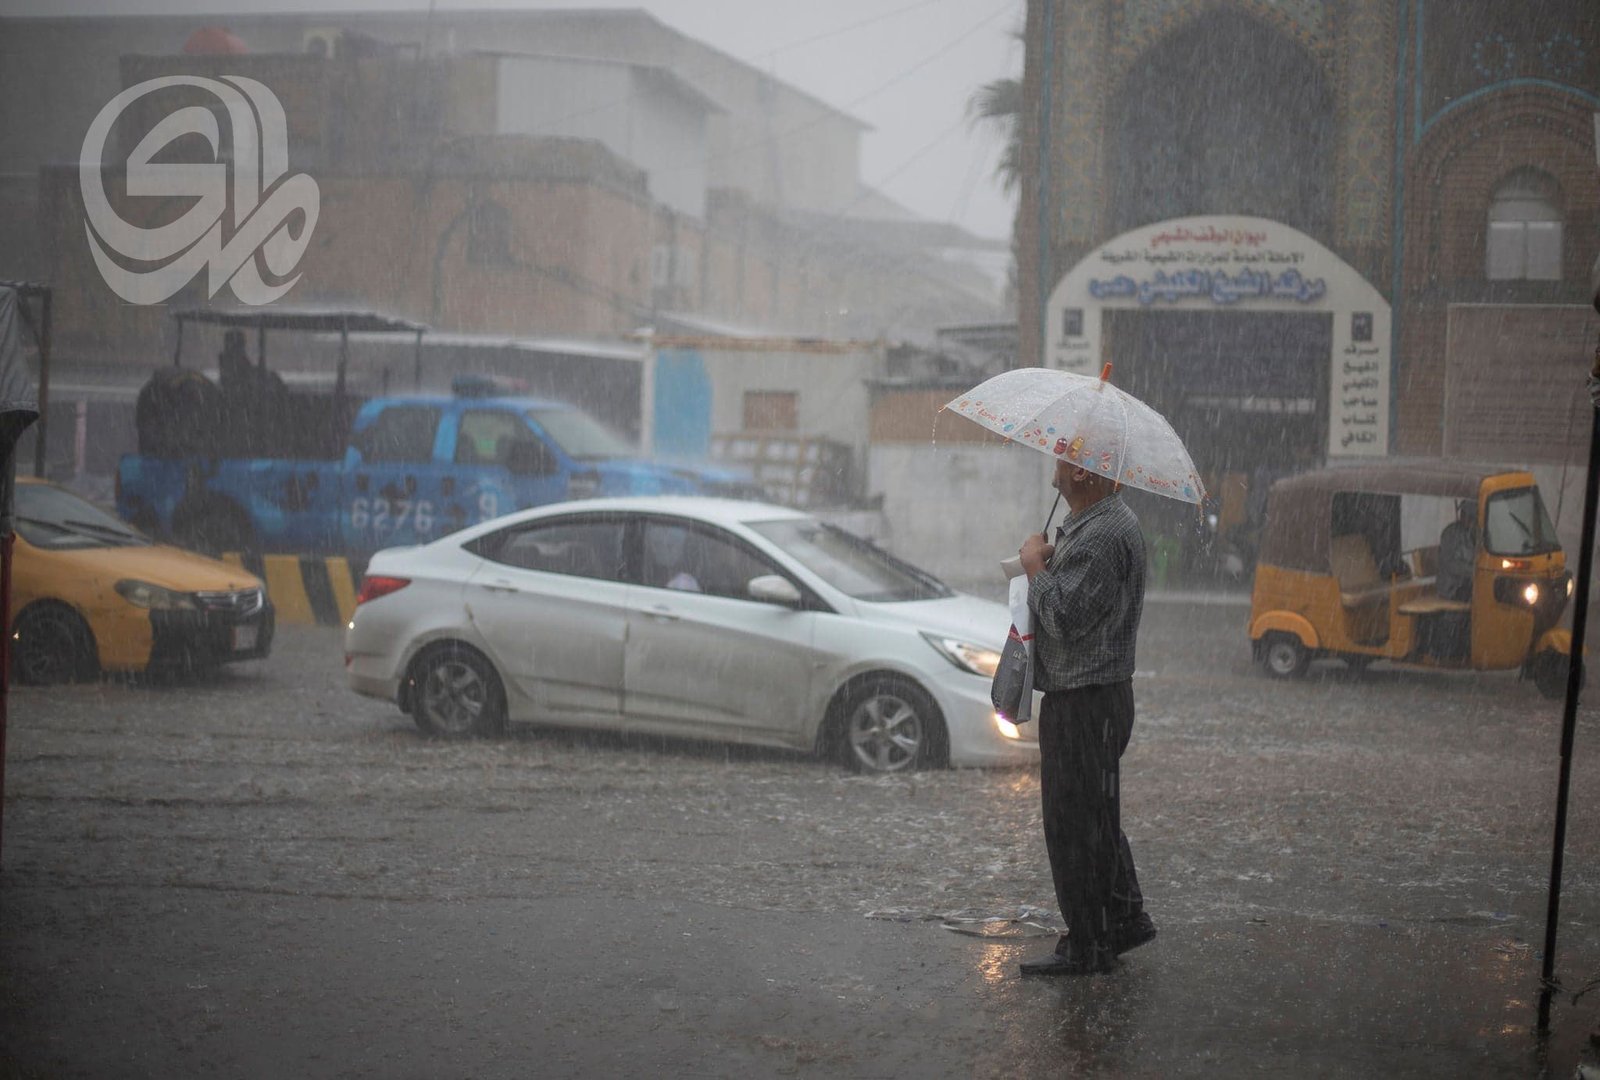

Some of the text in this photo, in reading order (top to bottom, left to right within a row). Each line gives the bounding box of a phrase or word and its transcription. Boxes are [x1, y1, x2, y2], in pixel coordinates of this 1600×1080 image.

[1151, 227, 1190, 248] الشيعي
[1192, 226, 1232, 245] الوقف
[1138, 267, 1210, 305] الكليني
[1211, 266, 1270, 304] الشيخ
[1272, 266, 1327, 303] مرقد
[1340, 430, 1378, 449] الكافي
[352, 497, 433, 532] 6276
